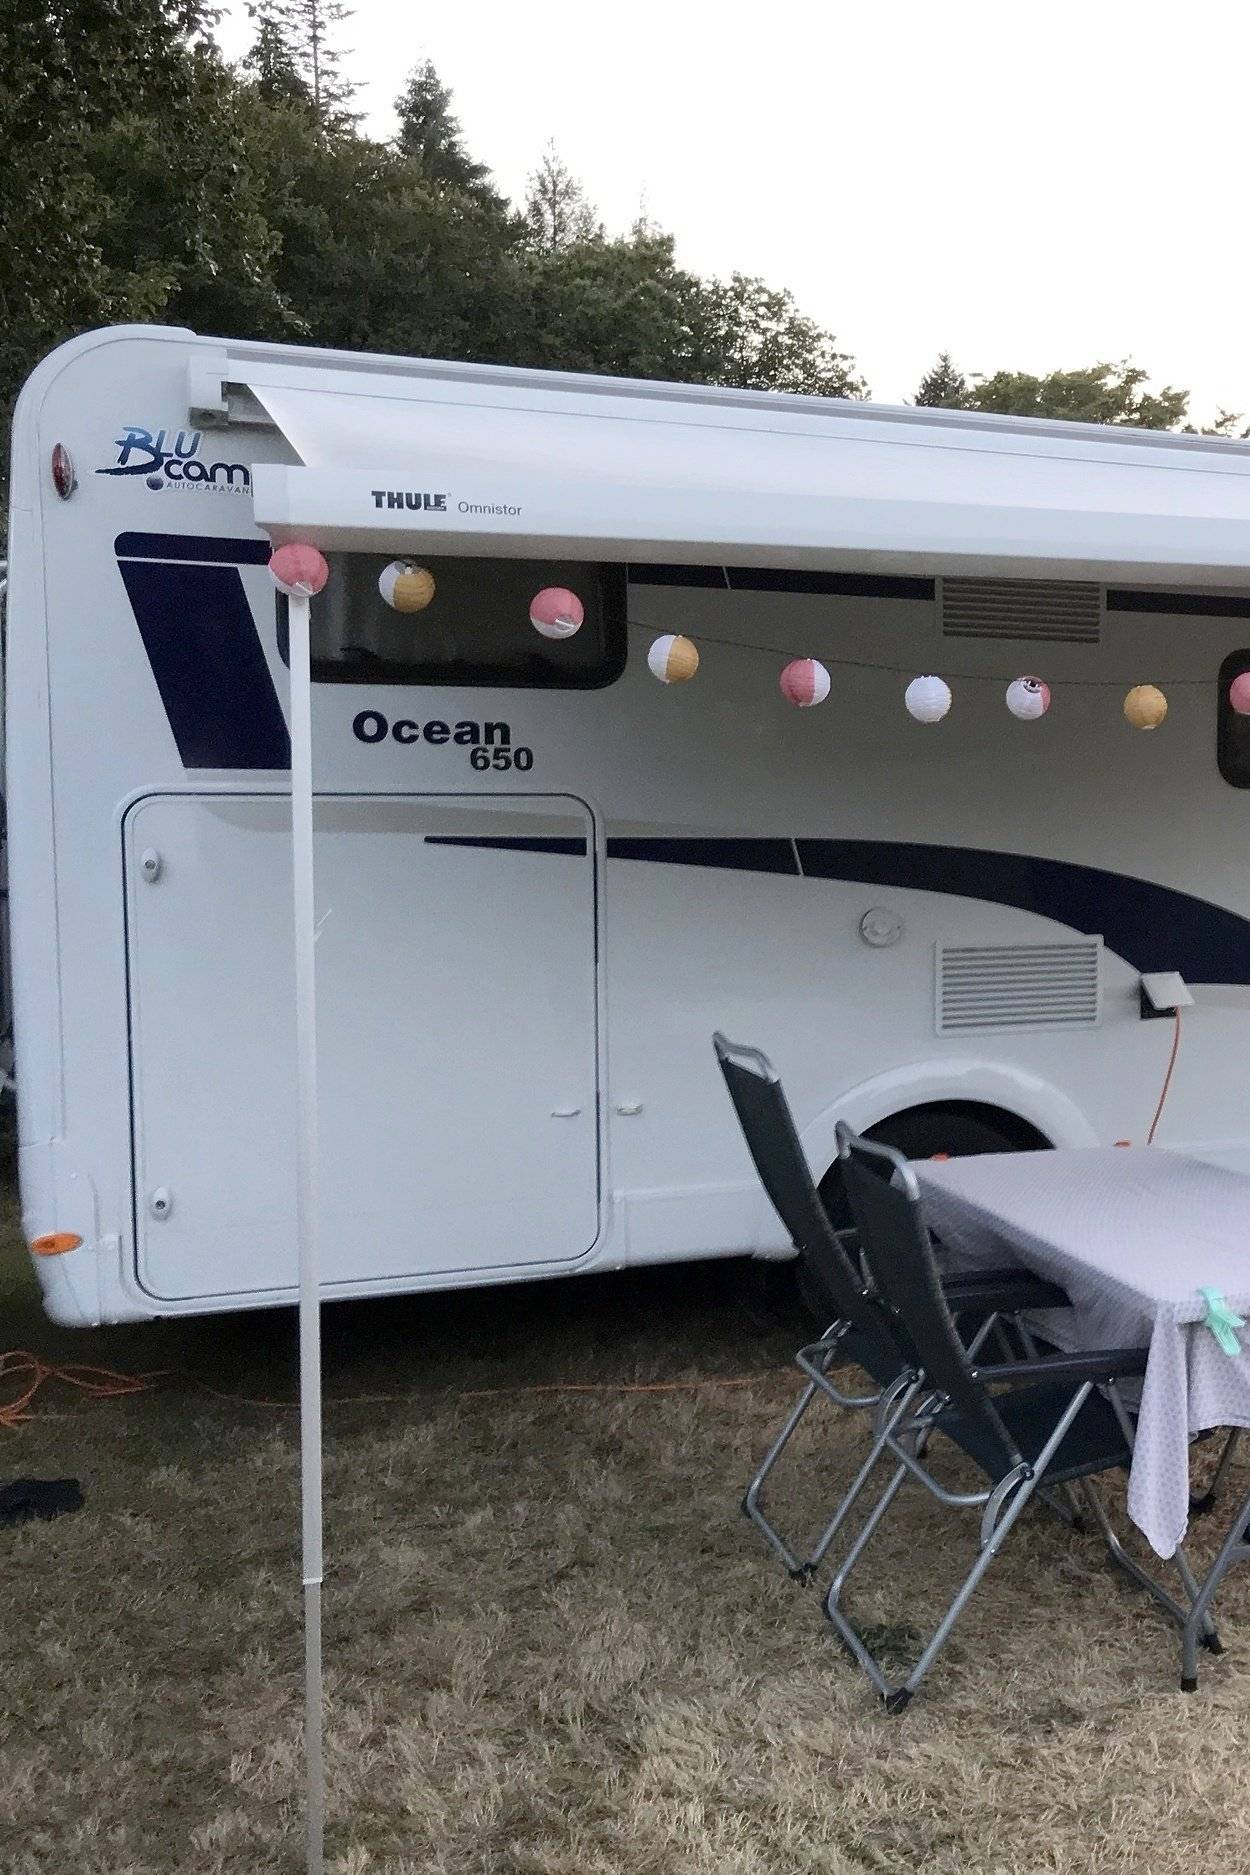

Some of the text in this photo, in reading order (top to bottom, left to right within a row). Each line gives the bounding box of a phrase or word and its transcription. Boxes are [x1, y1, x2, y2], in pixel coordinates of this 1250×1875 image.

[163, 458, 250, 486] cam
[371, 490, 523, 516] THULE Omnistor
[352, 709, 511, 746] Ocean
[470, 746, 534, 771] 650
